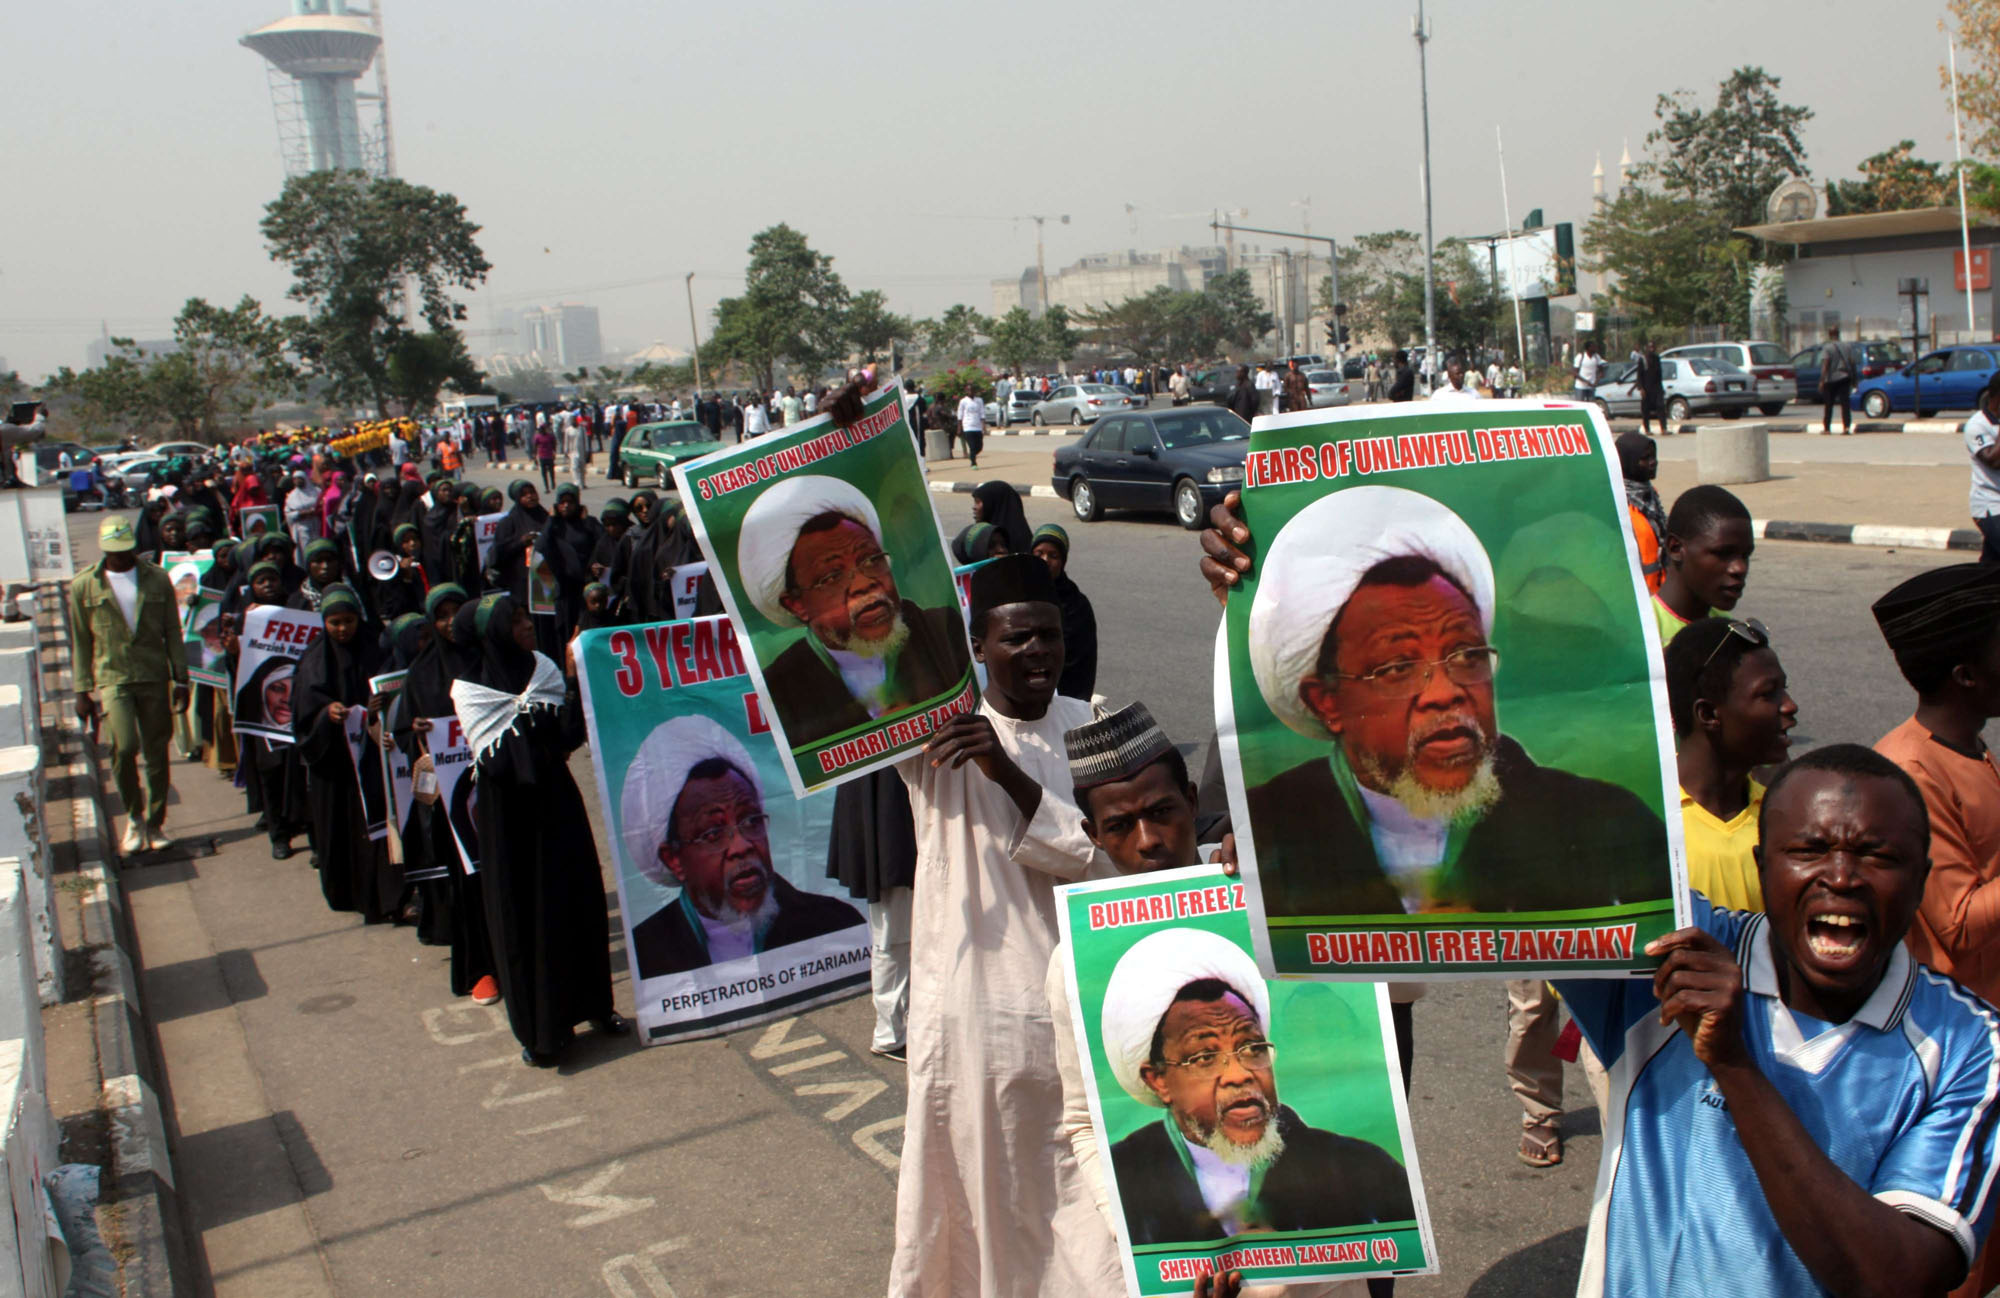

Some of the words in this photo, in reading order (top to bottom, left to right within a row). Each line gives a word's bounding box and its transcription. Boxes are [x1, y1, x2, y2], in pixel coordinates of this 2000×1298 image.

[698, 478, 713, 501] 3
[710, 461, 759, 497] YEARS
[756, 455, 777, 480] OF
[777, 426, 852, 473] UNLAWFUL
[849, 400, 902, 445] DETENTION
[1245, 442, 1318, 489] YEARS
[1319, 439, 1351, 479] OF
[1352, 429, 1476, 475] UNLAWFUL
[1474, 423, 1592, 462] DETENTION
[610, 630, 645, 697] 3
[643, 616, 748, 691] YEAR
[817, 728, 889, 774] BUHARI
[886, 715, 931, 748] FREE
[1089, 893, 1174, 930] BUHARI
[1175, 884, 1230, 919] FREE
[1231, 883, 1247, 912] Z
[1306, 930, 1424, 965] BUHARI
[1425, 929, 1498, 963] FREE
[1499, 923, 1637, 962] ZAKZAKY
[661, 977, 776, 1013] PERPETRATORS
[778, 967, 797, 985] OF
[800, 946, 873, 978] #ZARIAMA
[1159, 1256, 1215, 1282] SHEIKH
[1216, 1249, 1297, 1273] IBRAHEEM
[1296, 1240, 1368, 1265] ZAKZAKY
[1371, 1237, 1398, 1264] (H)
